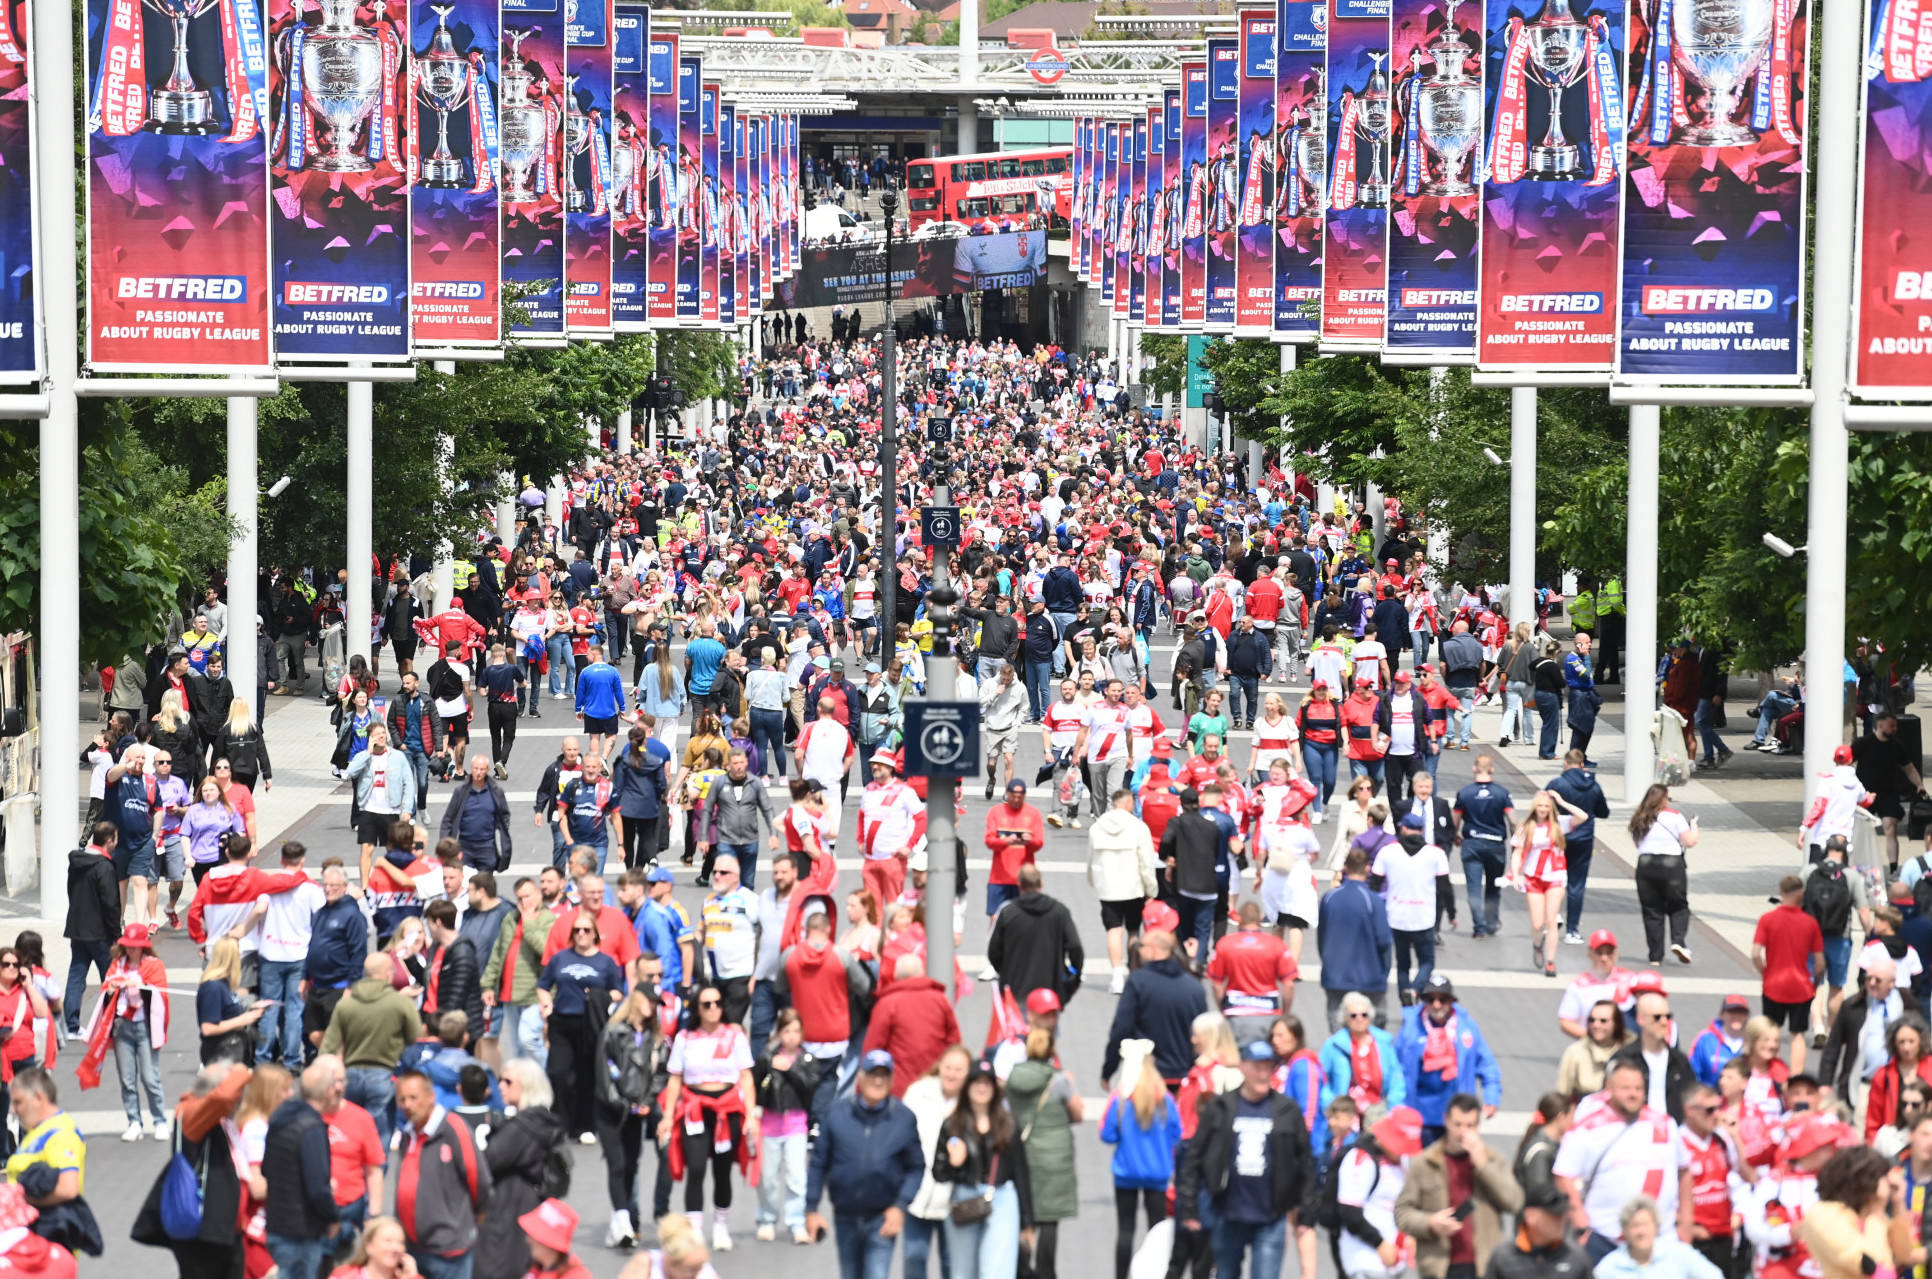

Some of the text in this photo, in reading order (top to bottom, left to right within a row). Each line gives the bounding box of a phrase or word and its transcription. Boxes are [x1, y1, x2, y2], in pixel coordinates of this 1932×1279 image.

[1598, 53, 1623, 128] BETFRED
[1653, 60, 1669, 143] BETFRED
[290, 102, 303, 168] BETFRED
[1408, 140, 1417, 194] BETFRED
[823, 277, 838, 288] SEE
[840, 275, 856, 286] YOU
[859, 274, 868, 284] AT
[871, 272, 886, 283] THE
[977, 273, 1031, 290] BETFRED
[118, 276, 242, 300] BETFRED
[289, 285, 387, 302] BETFRED
[1501, 295, 1600, 312] BETFRED
[1647, 288, 1773, 311] BETFRED
[136, 310, 224, 323] PASSIONATE
[303, 311, 373, 322] PASSIONATE
[423, 315, 453, 324] RUGBY
[457, 316, 493, 325] LEAGUE
[1328, 317, 1356, 325] ABOUT
[1417, 312, 1475, 321] PASSIONATE
[276, 323, 402, 335] ABOUT RUGBY LEAGUE
[1394, 323, 1424, 332] ABOUT
[1428, 323, 1459, 332] RUGBY
[1515, 321, 1585, 331] PASSIONATE
[1665, 321, 1754, 334] PASSIONATE
[100, 327, 260, 341] ABOUT RUGBY LEAGUE
[1487, 334, 1614, 344] ABOUT RUGBY LEAGUE
[1629, 337, 1790, 351] ABOUT RUGBY LEAGUE
[1095, 592, 1103, 604] 6
